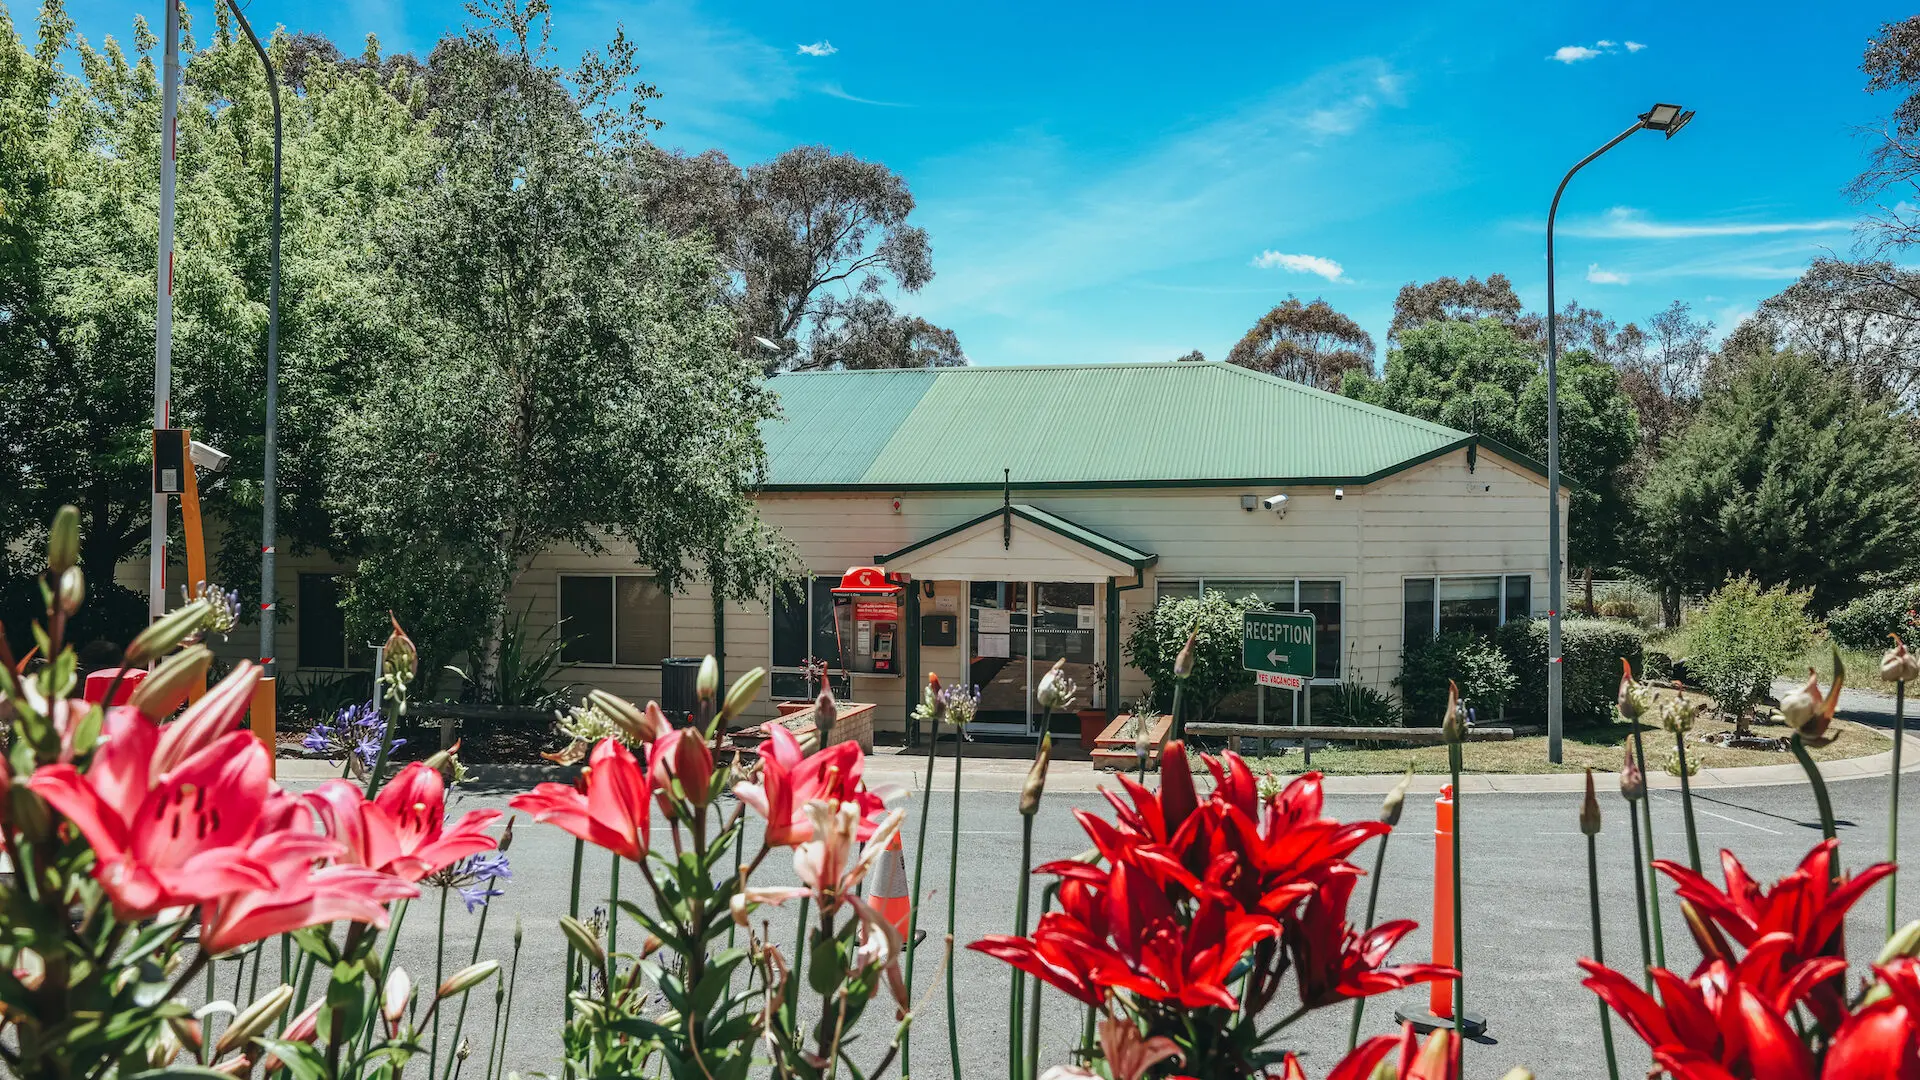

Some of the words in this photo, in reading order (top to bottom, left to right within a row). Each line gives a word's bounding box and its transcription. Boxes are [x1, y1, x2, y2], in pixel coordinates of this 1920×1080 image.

[1246, 622, 1311, 645] RECEPTION
[1259, 674, 1268, 683] YES
[1270, 676, 1300, 688] VACANCIES
